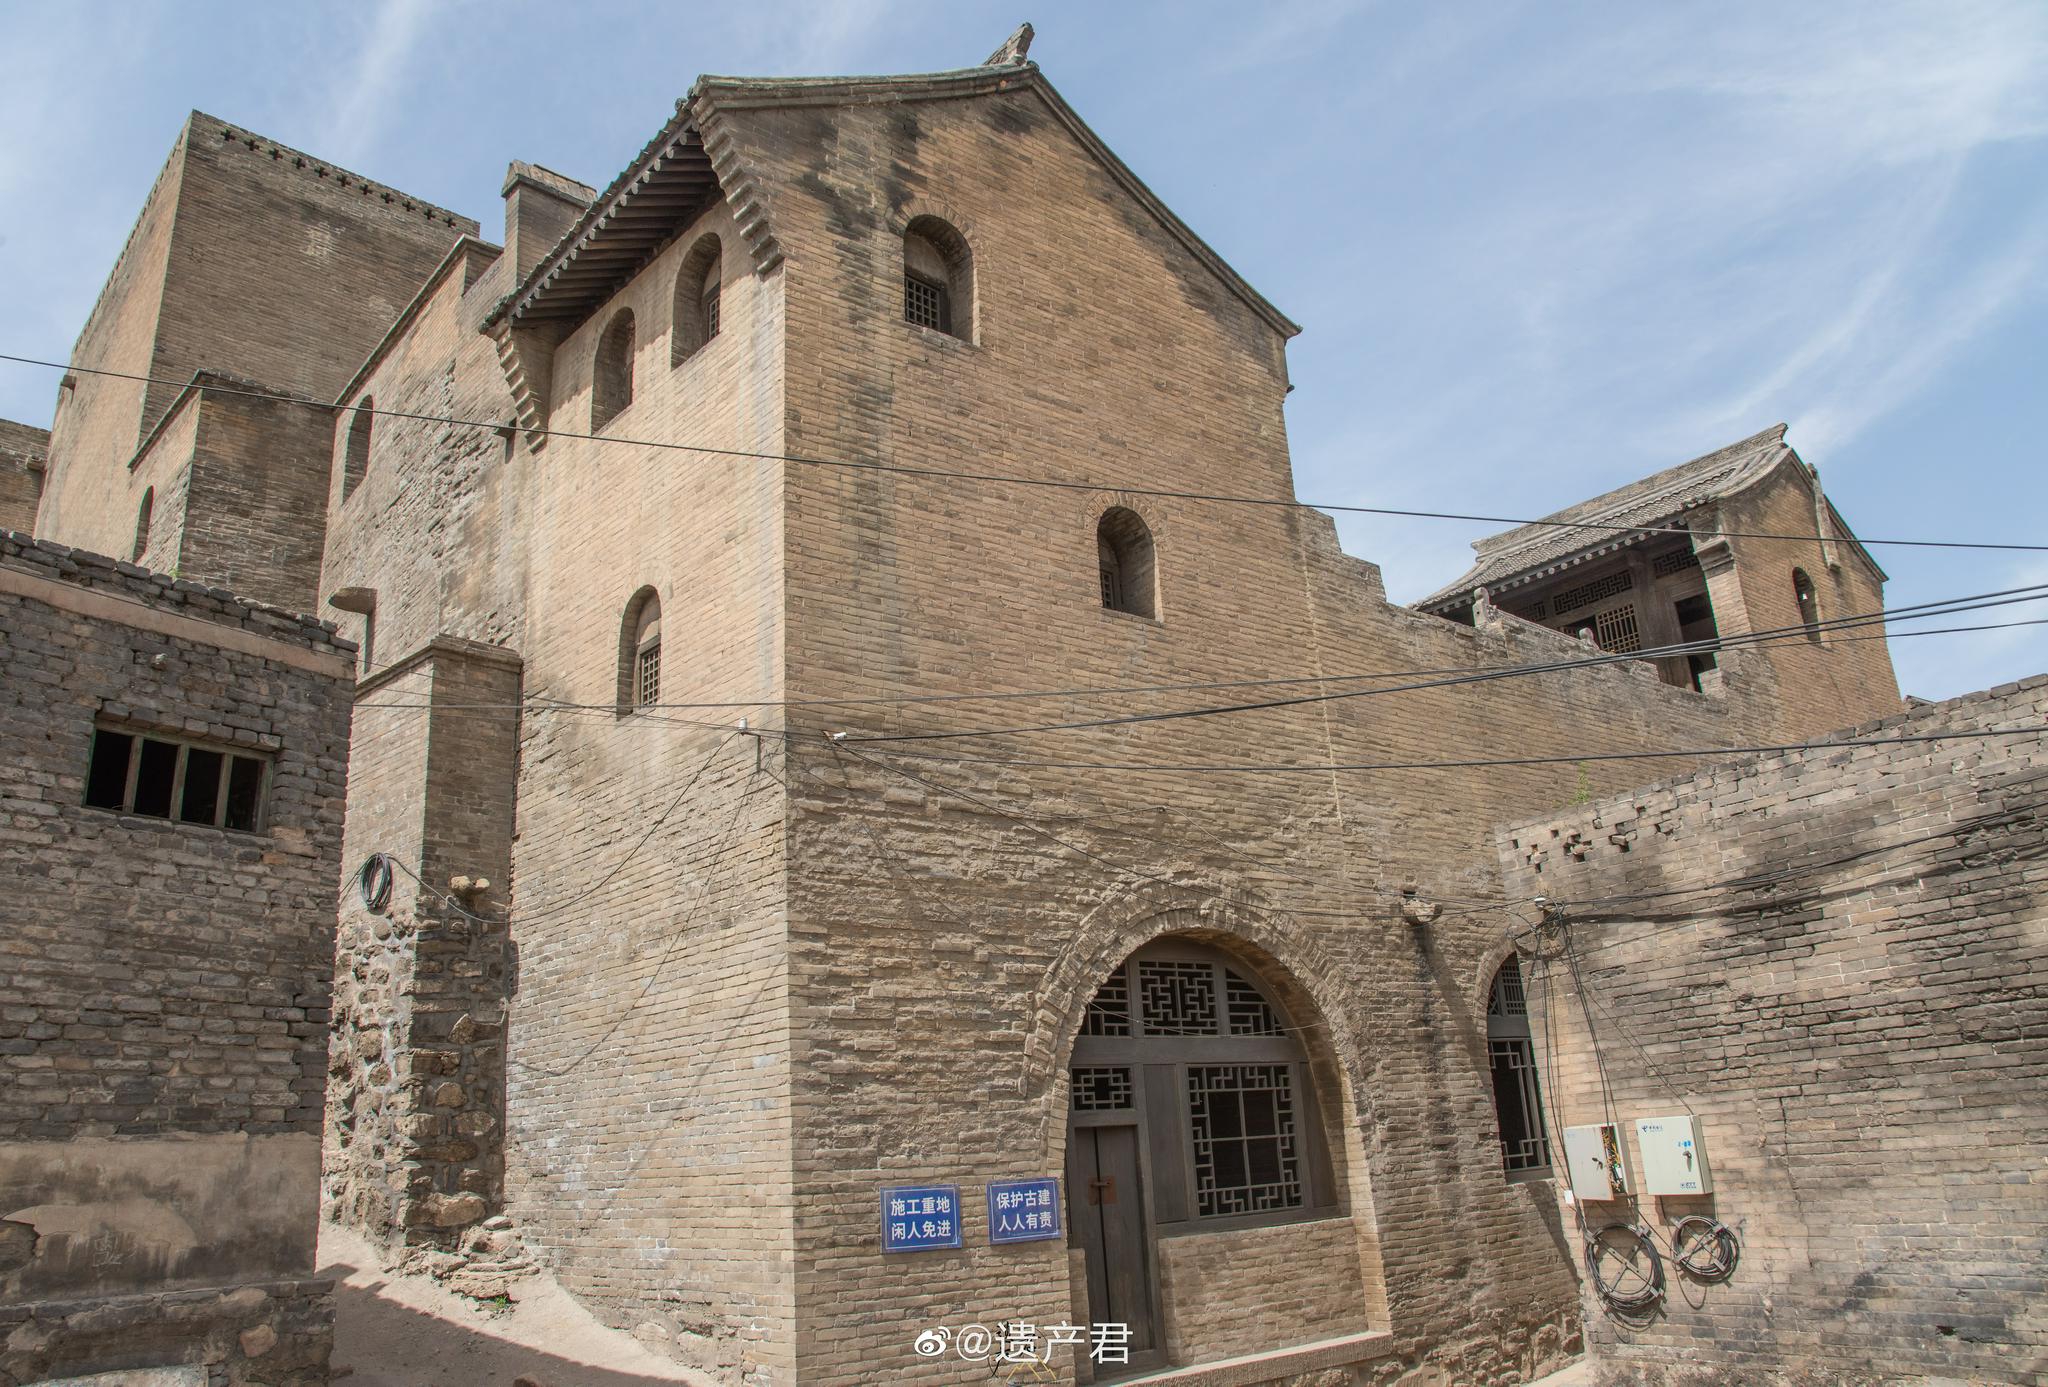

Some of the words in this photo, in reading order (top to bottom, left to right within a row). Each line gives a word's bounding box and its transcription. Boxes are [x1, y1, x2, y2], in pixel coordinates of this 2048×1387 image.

[890, 1196, 951, 1217] 施工重地
[996, 1188, 1051, 1210] 保护古建
[891, 1220, 952, 1240] 闲人免进
[998, 1212, 1052, 1233] 人人有责
